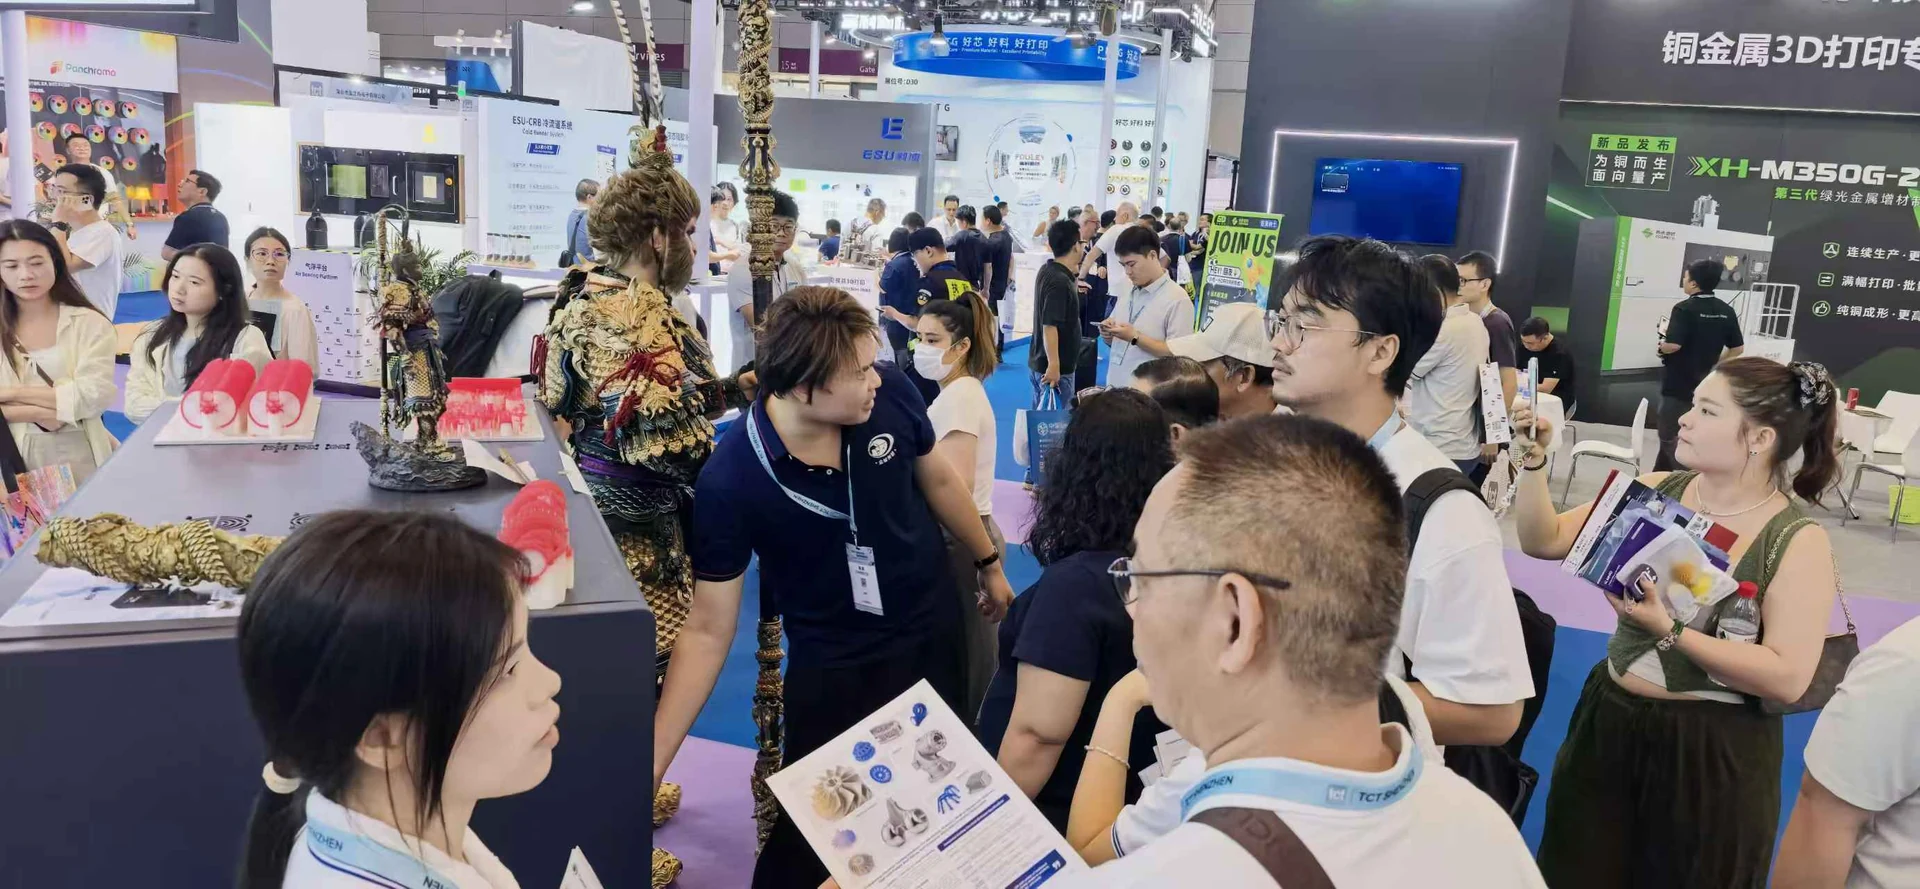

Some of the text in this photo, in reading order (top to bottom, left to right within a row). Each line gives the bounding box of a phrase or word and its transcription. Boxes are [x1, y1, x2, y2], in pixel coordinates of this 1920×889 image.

[963, 37, 983, 48] 好芯
[988, 37, 1009, 48] 好料
[1015, 38, 1049, 50] 好打印
[65, 63, 117, 77] Panchroma
[860, 66, 876, 74] Gate
[512, 115, 542, 127] ESU-CRB
[1597, 136, 1671, 151] 新品发布
[863, 149, 895, 161] ESU
[1594, 153, 1668, 171] 为铜而生
[1592, 168, 1666, 185] 面向量产
[1209, 230, 1277, 258] JOIN US
[1359, 791, 1383, 803] TCT
